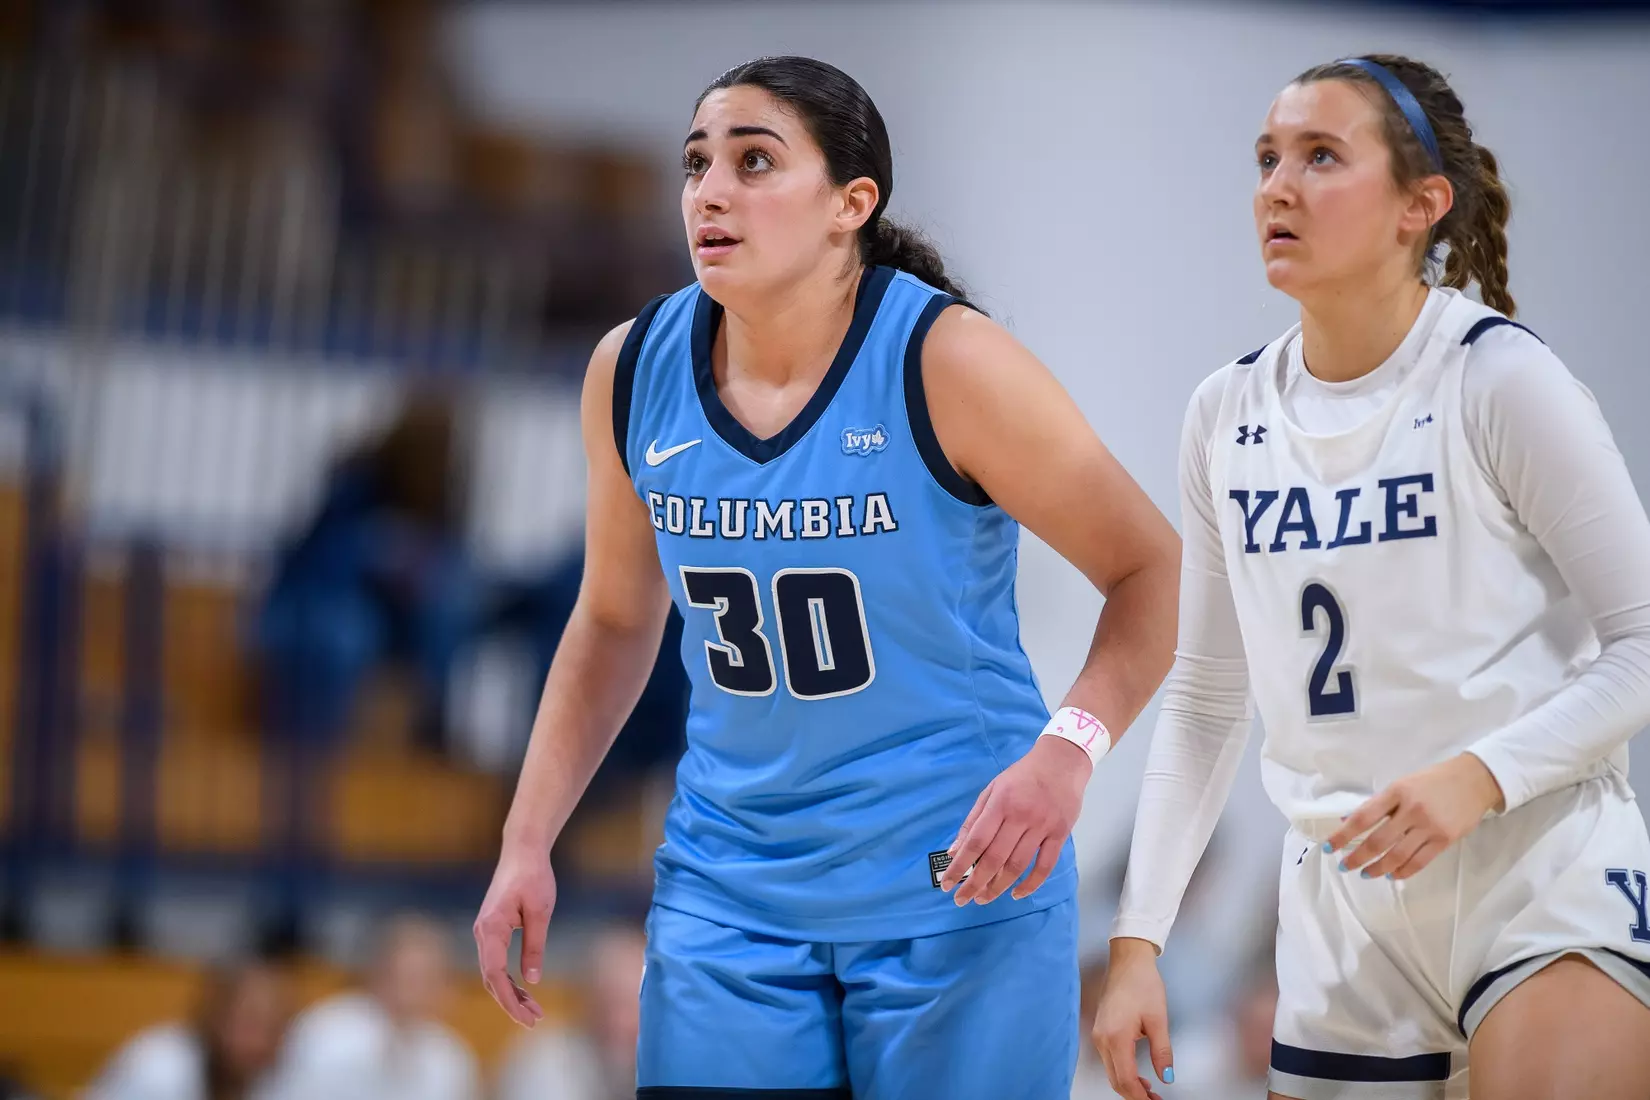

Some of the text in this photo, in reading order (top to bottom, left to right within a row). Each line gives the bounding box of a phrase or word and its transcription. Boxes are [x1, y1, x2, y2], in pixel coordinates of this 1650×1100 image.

[845, 432, 871, 450] Ivy
[647, 489, 899, 540] COLUMBIA
[1229, 473, 1437, 554] YALE
[678, 565, 876, 700] 30
[1300, 577, 1361, 724] 2
[1604, 868, 1650, 944] Y
